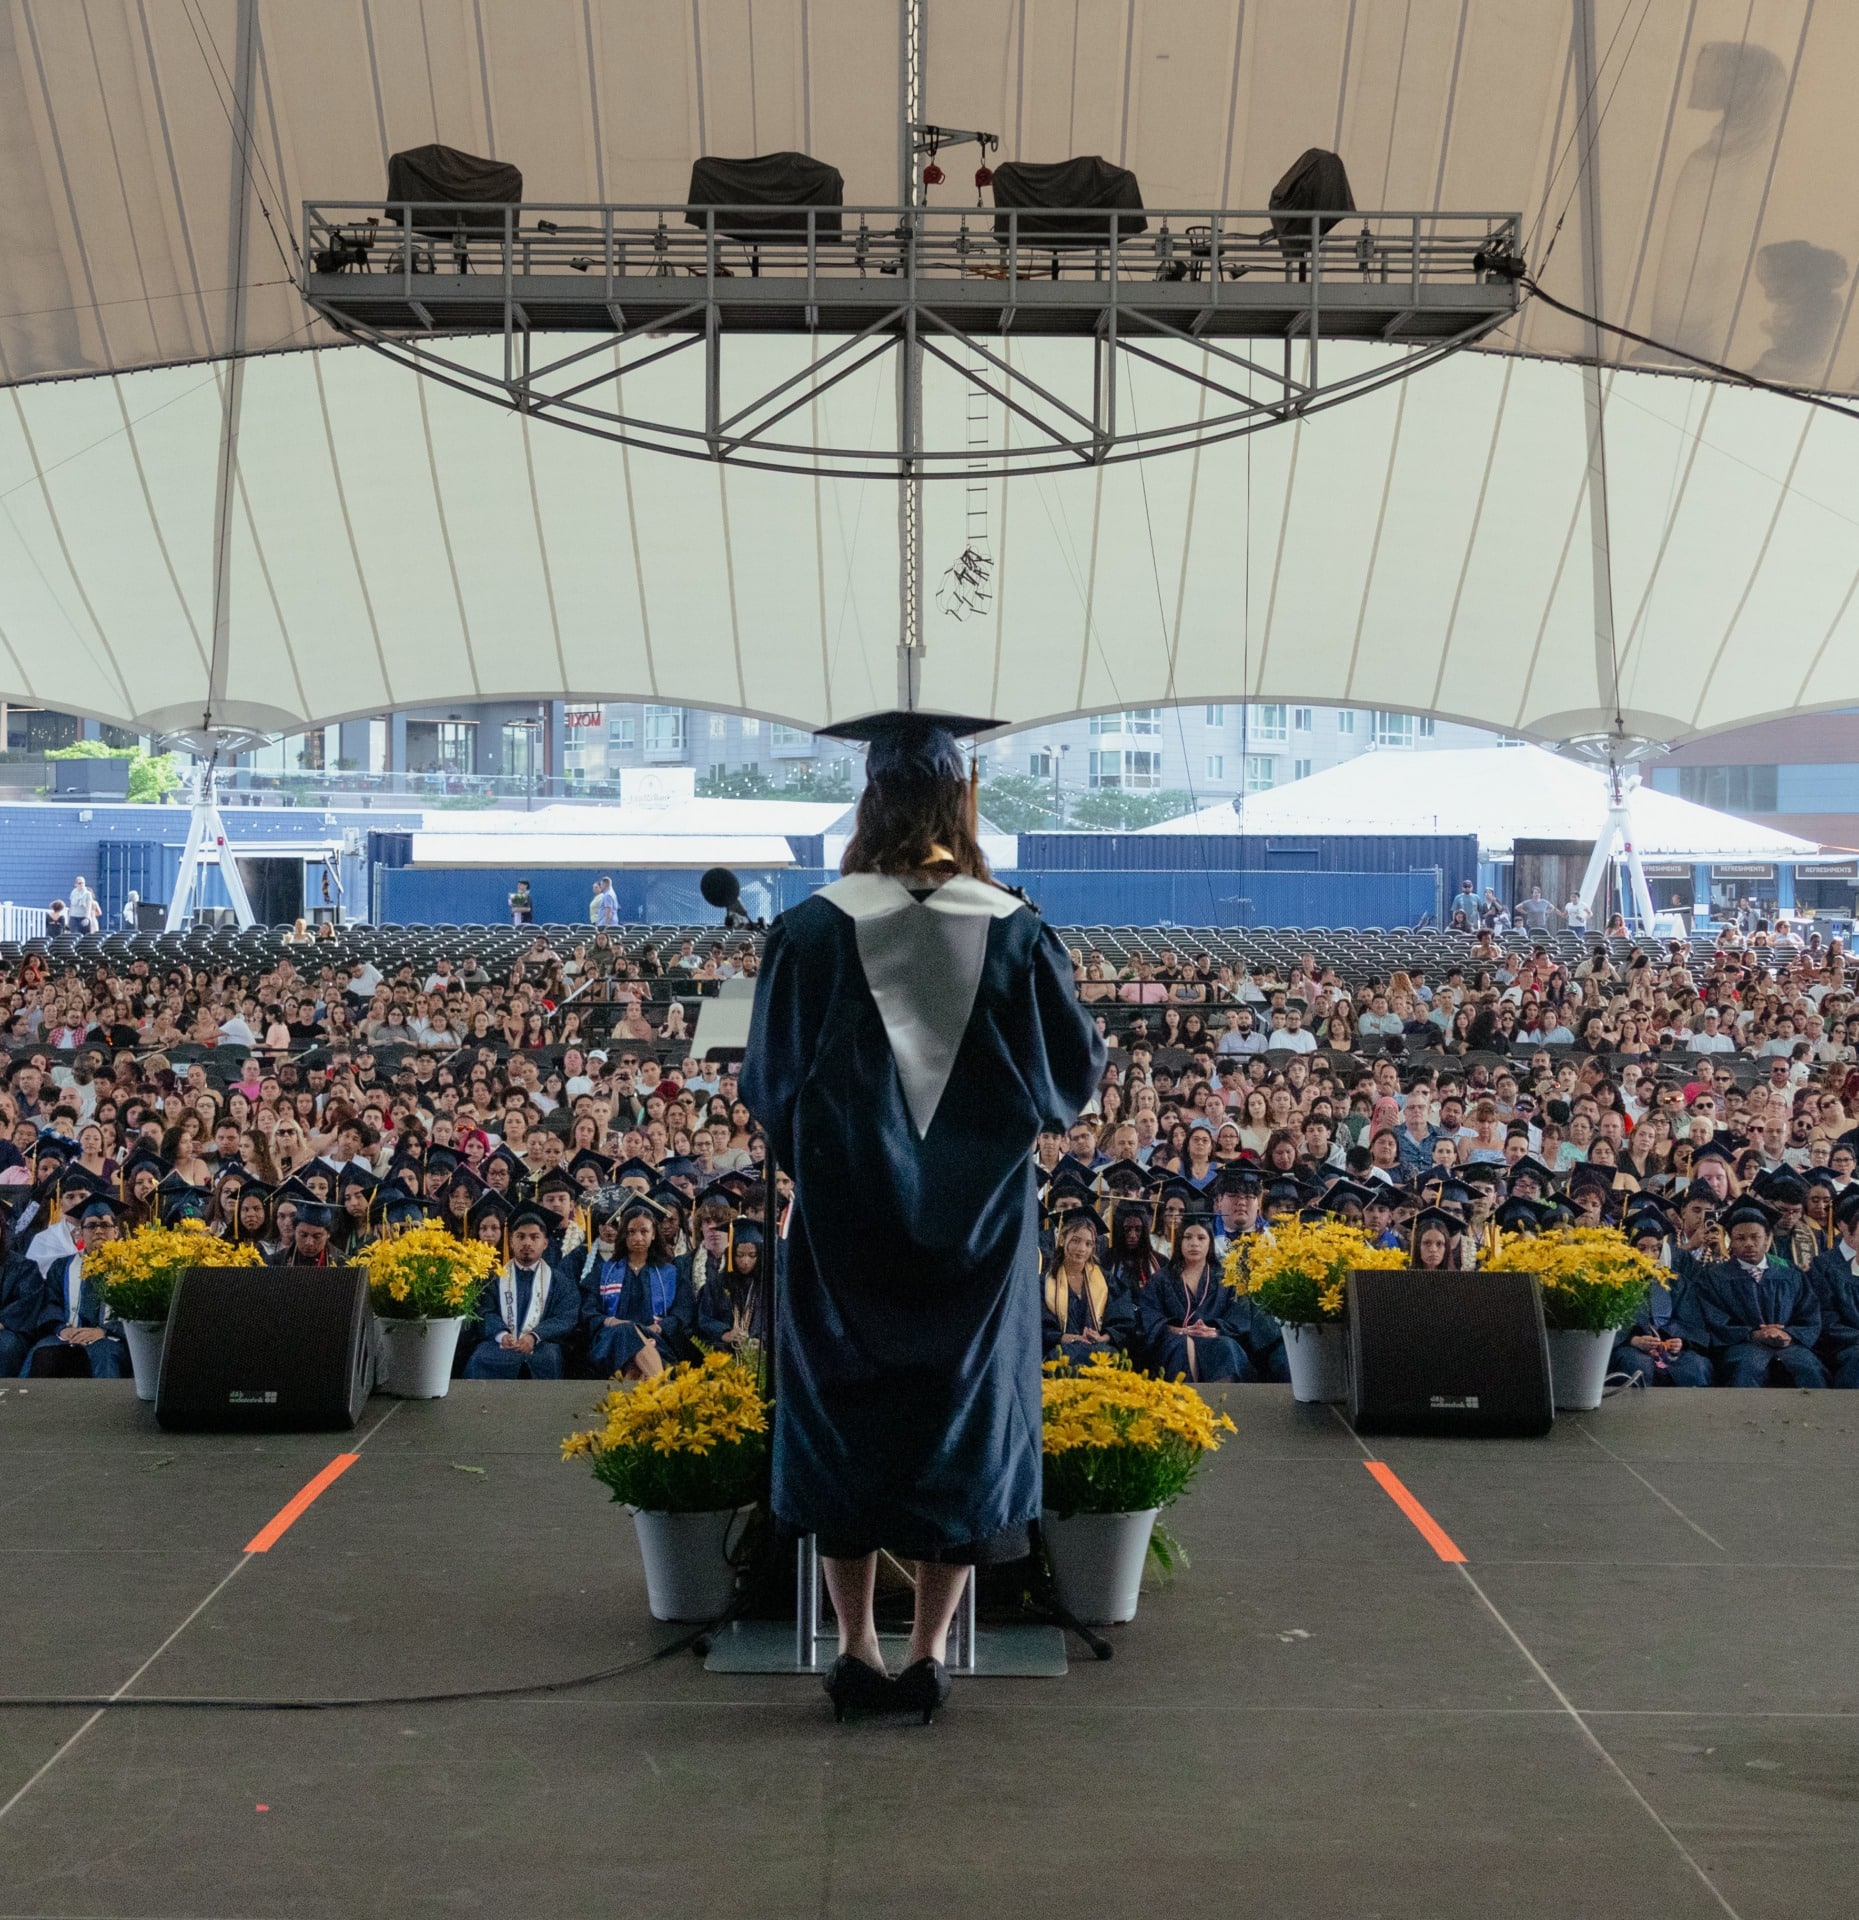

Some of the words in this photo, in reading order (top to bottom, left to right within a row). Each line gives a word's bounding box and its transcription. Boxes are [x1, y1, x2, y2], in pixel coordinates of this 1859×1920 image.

[1642, 865, 1682, 873] EFRESHMENTS
[1720, 865, 1766, 873] REFRESHMENTS
[1805, 866, 1852, 874] REFRESHMENTS
